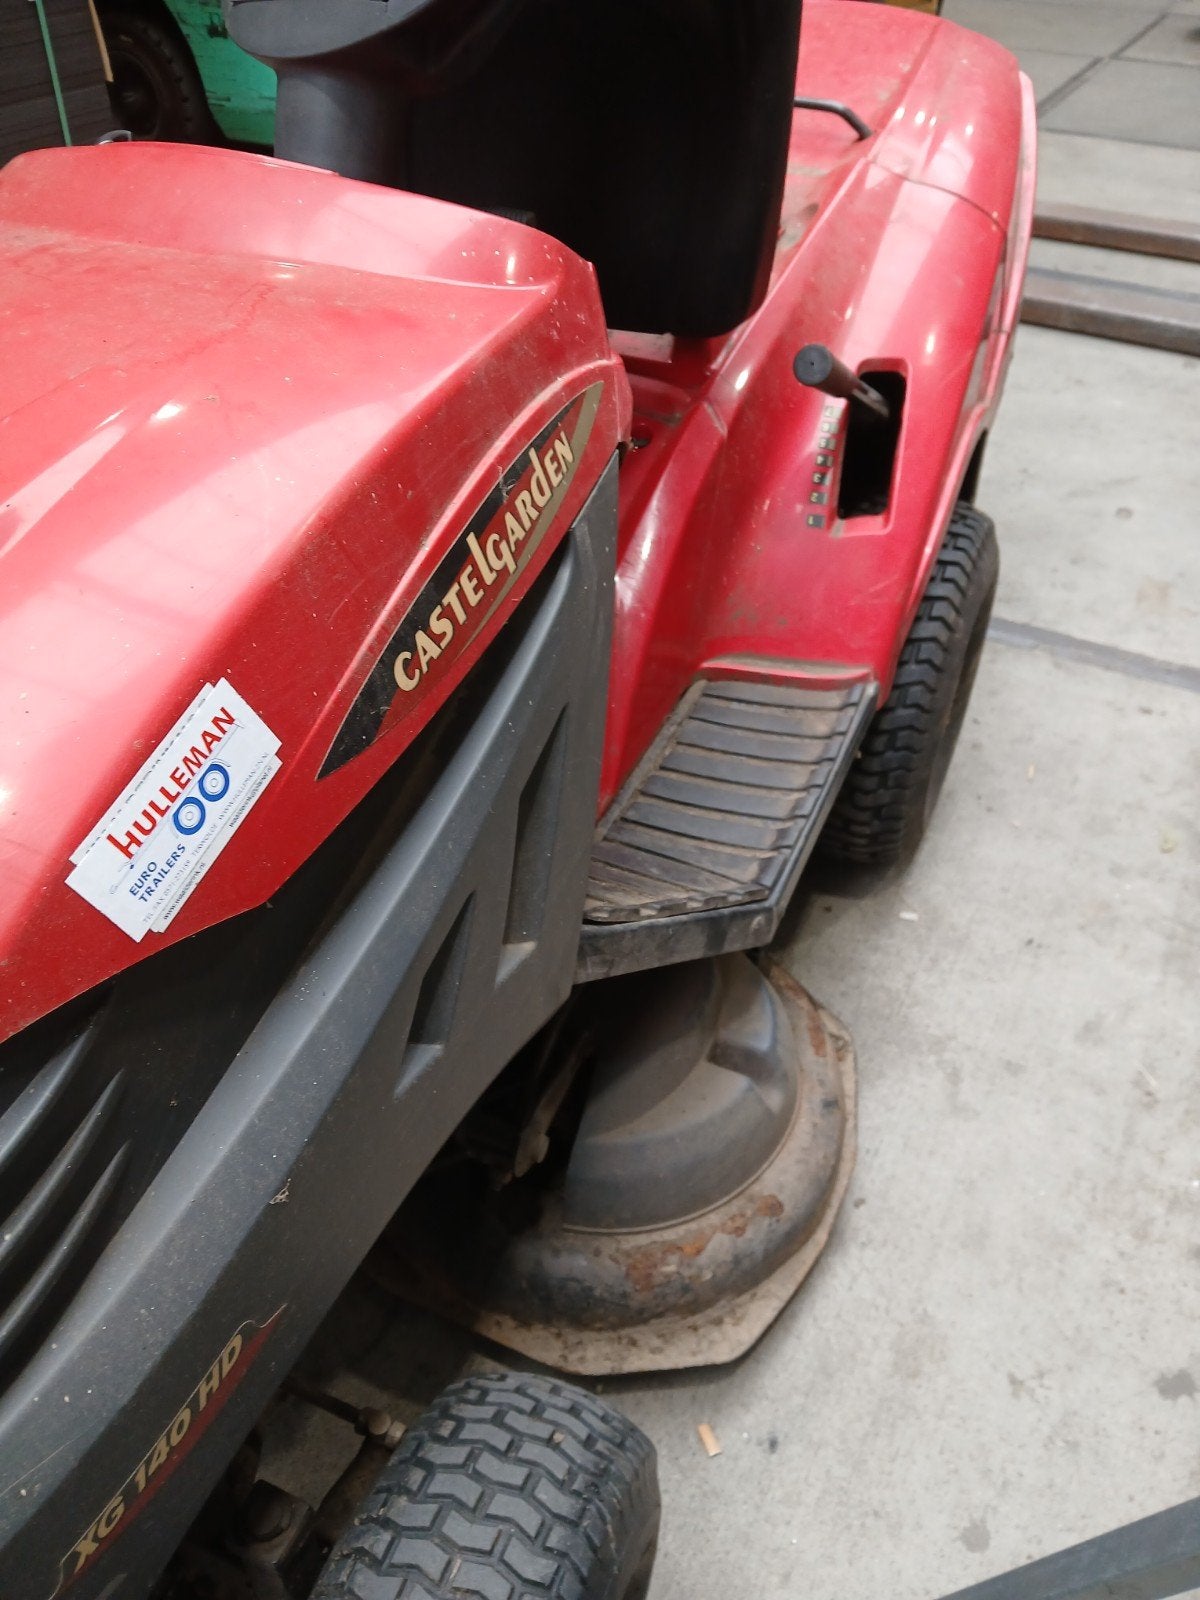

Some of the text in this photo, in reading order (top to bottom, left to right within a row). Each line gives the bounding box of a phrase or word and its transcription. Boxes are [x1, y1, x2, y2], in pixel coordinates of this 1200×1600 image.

[106, 706, 236, 859] HULLEMAN
[129, 861, 157, 897] EURO
[138, 844, 186, 904] TRAILERS
[74, 1334, 242, 1573] XG 140 HD
